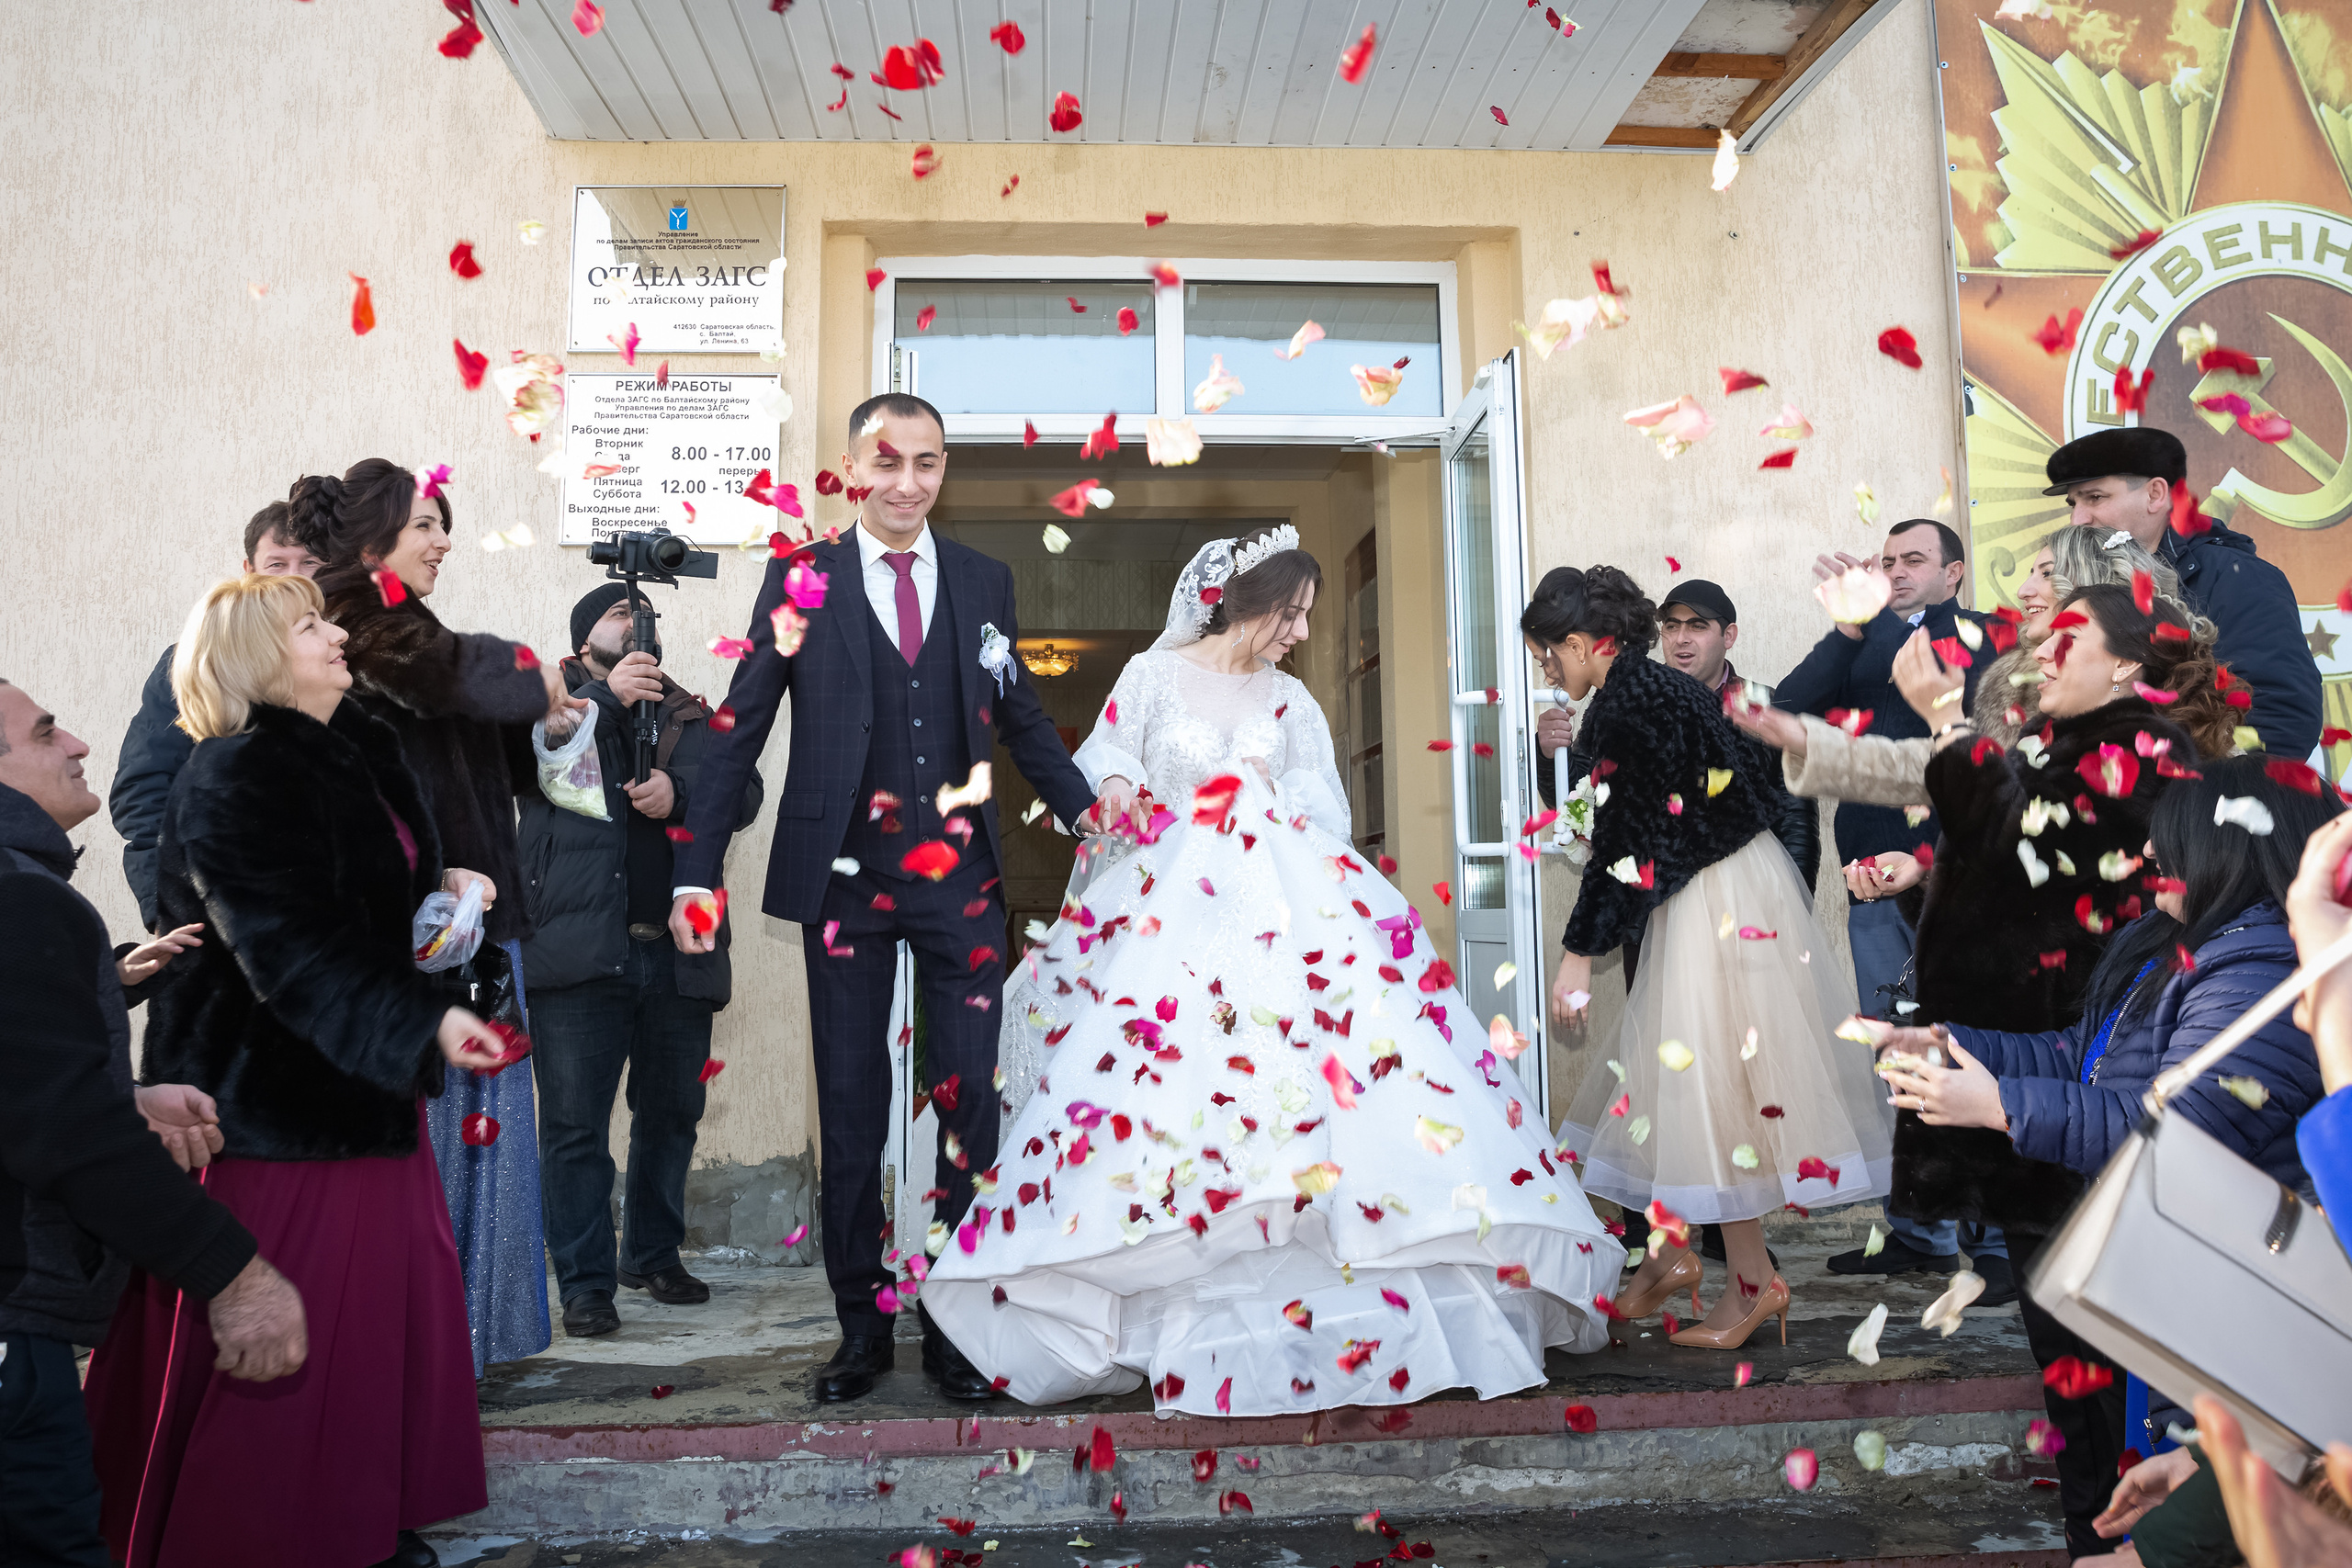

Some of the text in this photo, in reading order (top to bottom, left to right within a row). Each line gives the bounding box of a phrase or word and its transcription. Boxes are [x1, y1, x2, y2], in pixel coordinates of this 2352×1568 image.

[588, 265, 766, 290] ОТДЕЛ ЗАГС
[594, 294, 760, 308] по лтайскому району
[700, 323, 744, 332] Саратовская
[616, 380, 732, 392] РЕЖИМ РАБОТЫ
[595, 396, 626, 404] Отдела
[664, 396, 718, 405] Балтайскому
[720, 397, 750, 405] району
[594, 412, 658, 420] Правительства
[660, 412, 713, 421] Саратовской
[571, 425, 649, 436] Рабочие дни:
[595, 439, 644, 450] Вторник
[672, 446, 707, 460] 8.00
[725, 446, 771, 461] 17.00
[718, 468, 771, 477] переры
[594, 477, 643, 487] Пятница
[661, 479, 707, 494] 12.00
[594, 490, 641, 501] Суббота
[569, 504, 660, 515] Выходные дни:
[592, 517, 668, 528] Воскресенье
